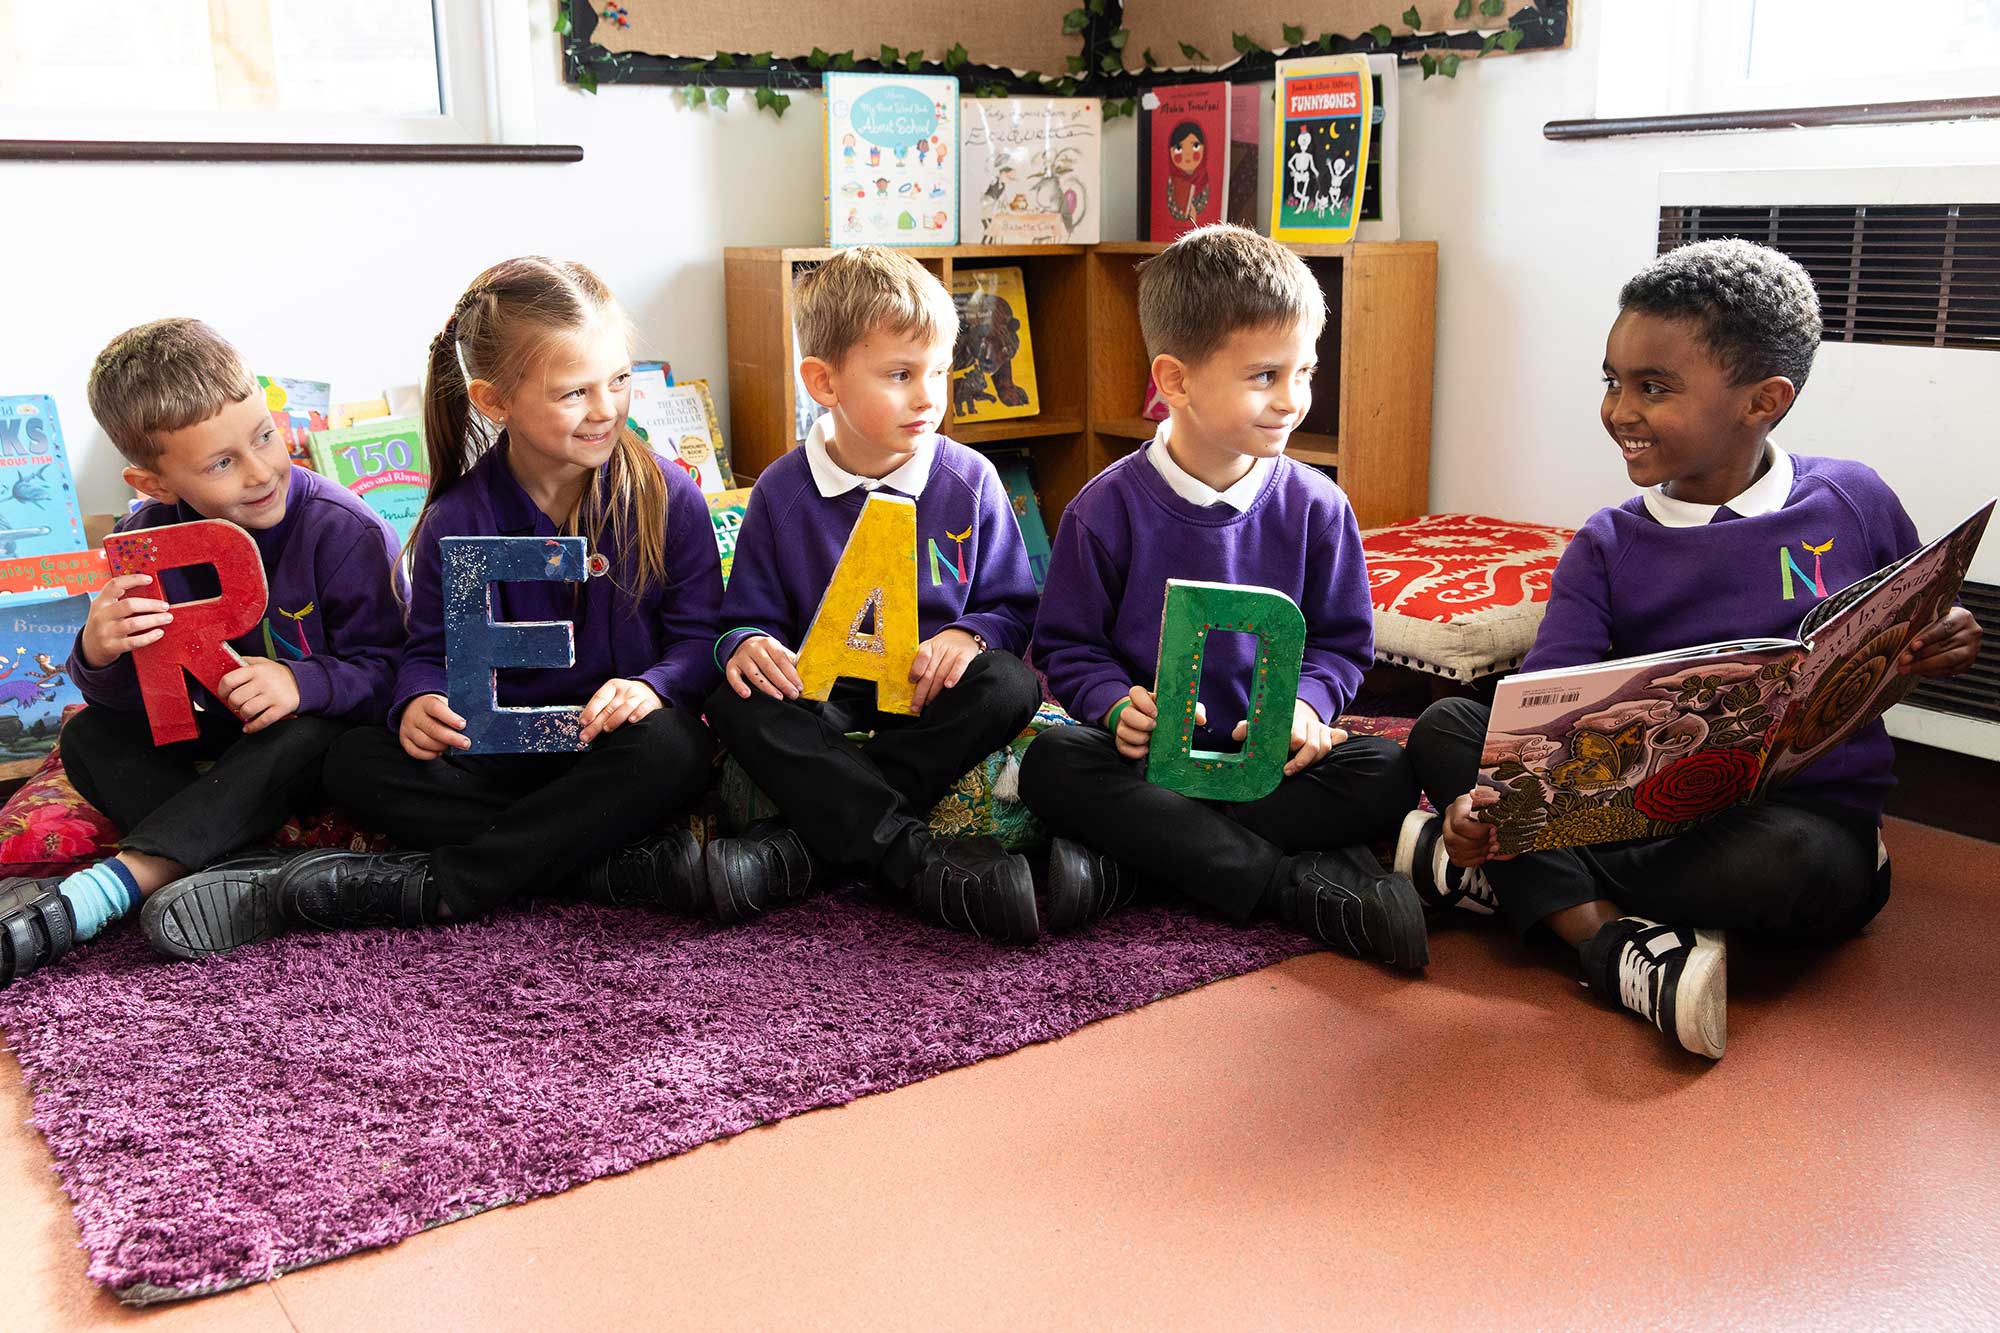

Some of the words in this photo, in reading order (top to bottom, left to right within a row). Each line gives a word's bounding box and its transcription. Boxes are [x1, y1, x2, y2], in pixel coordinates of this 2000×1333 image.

[1291, 92, 1357, 113] FUNNYBONES
[858, 117, 895, 134] About
[896, 116, 931, 135] School
[657, 400, 673, 410] THE
[674, 397, 697, 408] VERY
[665, 406, 699, 417] HUNGRY
[646, 414, 702, 427] CATERPILLAR
[0, 418, 49, 457] KS
[0, 457, 28, 466] ROUS
[31, 456, 53, 465] FISH
[342, 439, 413, 477] 150
[351, 480, 375, 494] tories
[375, 473, 392, 483] and
[0, 563, 35, 580] aisy
[40, 557, 89, 571] Goes
[41, 569, 113, 586] Shoppin
[1858, 607, 1878, 626] by
[1882, 557, 1942, 611] Swirl
[795, 491, 922, 717] A
[14, 619, 80, 634] Broom
[103, 518, 298, 747] R
[440, 536, 593, 754] E
[1146, 578, 1307, 803] D
